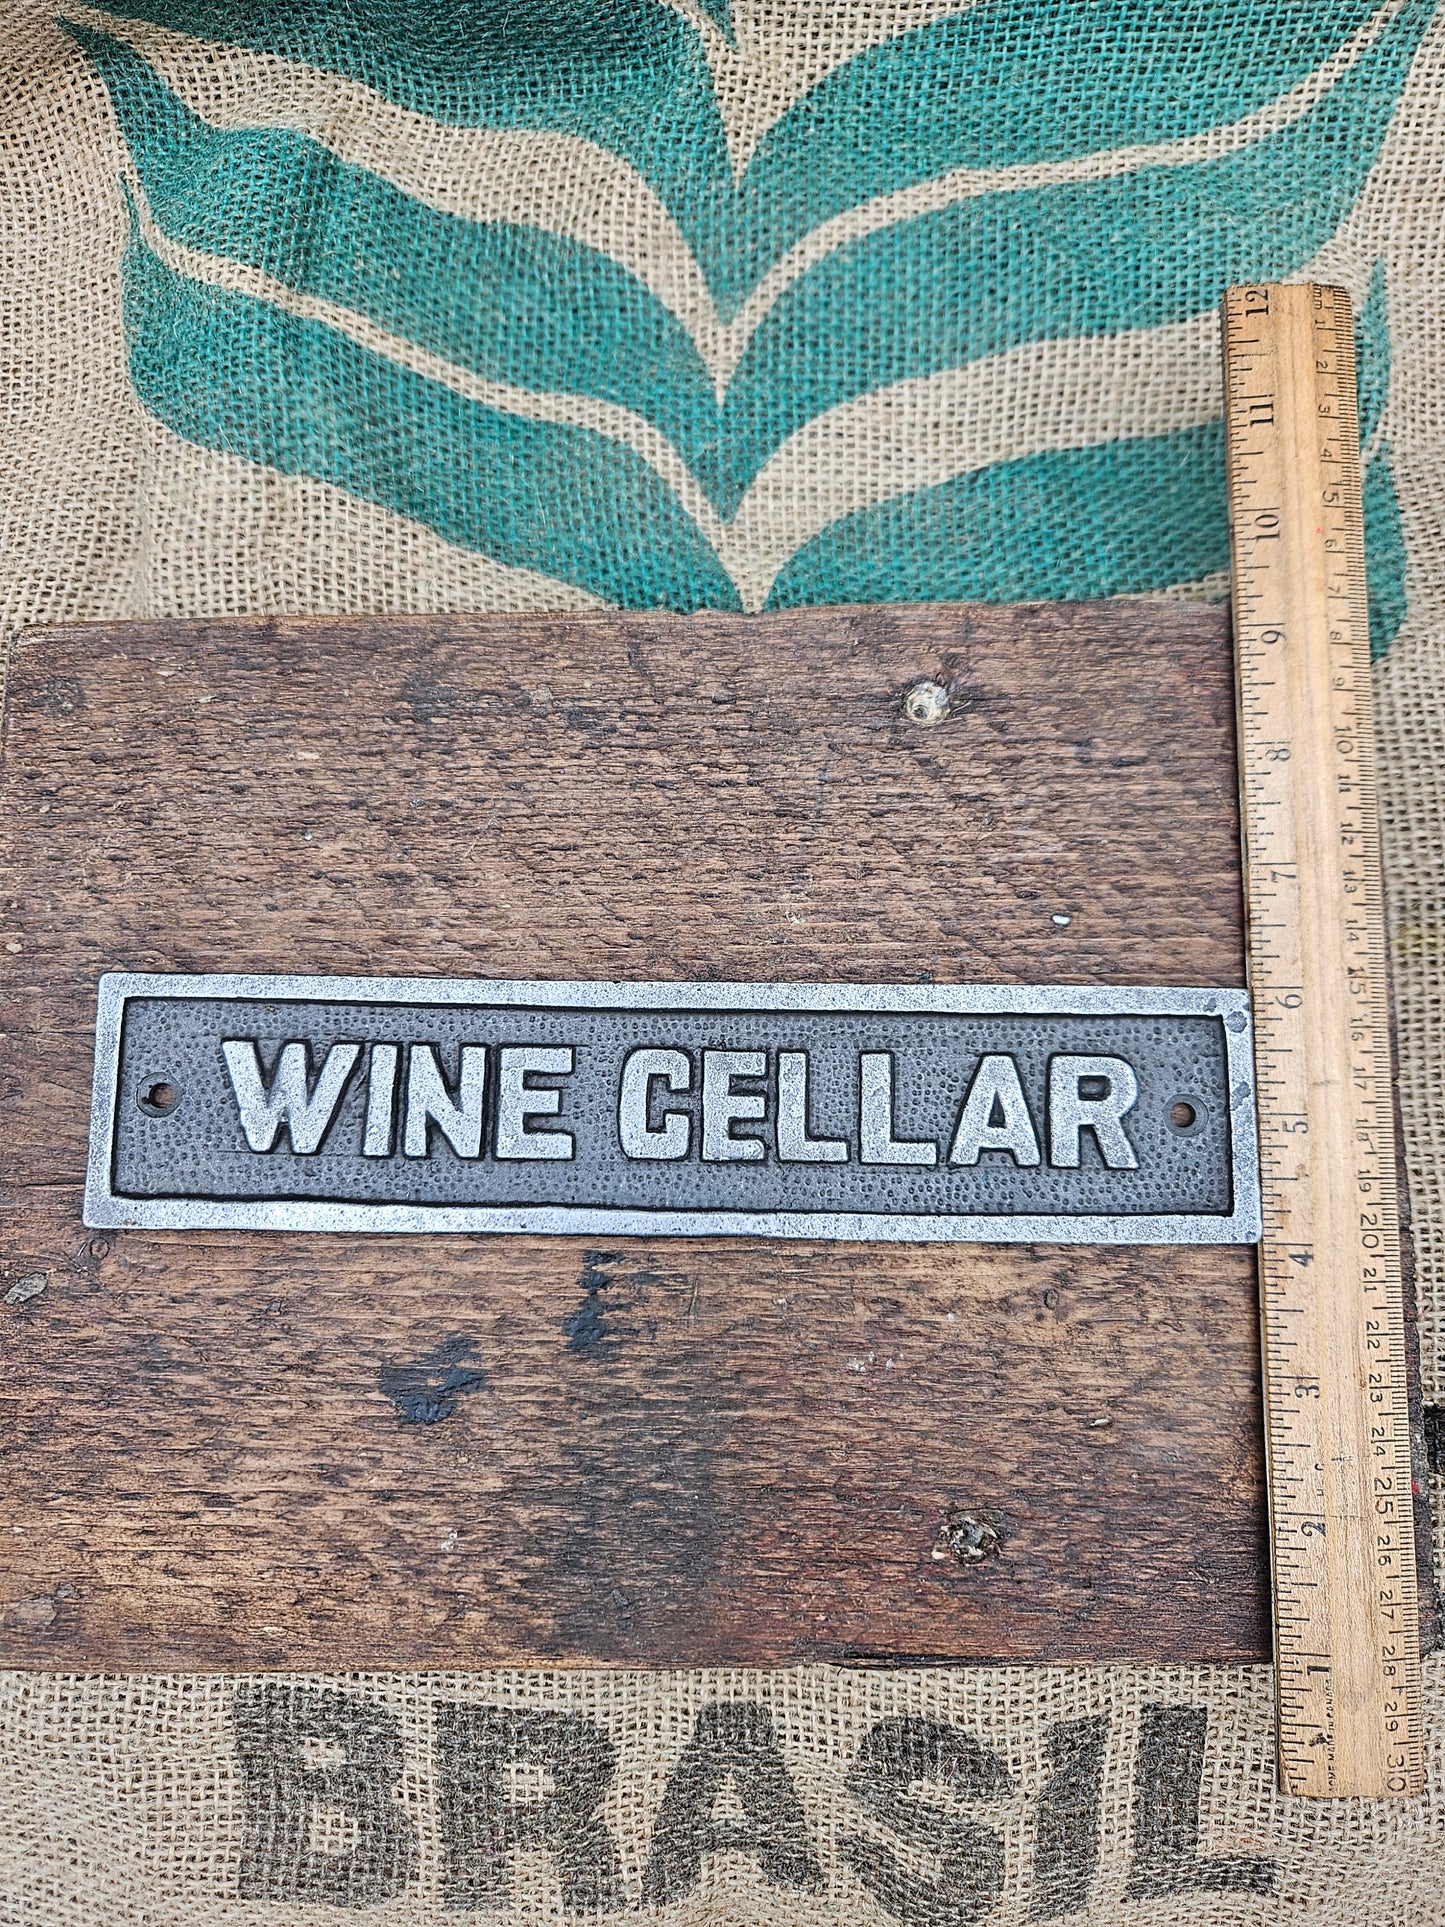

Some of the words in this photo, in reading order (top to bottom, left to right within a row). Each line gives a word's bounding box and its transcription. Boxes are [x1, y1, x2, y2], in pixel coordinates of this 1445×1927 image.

[1245, 288, 1269, 316] 12
[1314, 318, 1326, 326] 1
[1315, 360, 1328, 370] 2
[1249, 402, 1275, 427] 11
[1318, 404, 1330, 414] 3
[1320, 447, 1332, 458] 4
[1322, 489, 1340, 503] 5
[1254, 513, 1281, 542] 10
[1324, 538, 1337, 548] 6
[1328, 585, 1340, 593] 7
[1260, 629, 1286, 645] 9
[1329, 630, 1342, 641] 8
[1332, 677, 1345, 686] 9
[1334, 726, 1354, 754] 10
[1265, 748, 1291, 762] 8
[1337, 773, 1351, 794] 11
[1340, 821, 1355, 846] 12
[1270, 870, 1297, 884] 7
[1342, 869, 1357, 894] 13
[1345, 918, 1360, 942] 14
[1347, 966, 1367, 995] 15
[1275, 993, 1303, 1010] 6
[1350, 1016, 1365, 1042] 16
[1353, 1066, 1367, 1091] 17
[221, 1037, 575, 1160] WINE
[619, 1047, 1141, 1169] CELLAR
[1282, 1120, 1309, 1135] 5
[1356, 1117, 1370, 1142] 18
[1358, 1168, 1371, 1193] 19
[1360, 1213, 1379, 1249] 20
[1288, 1251, 1314, 1268] 4
[1363, 1267, 1377, 1293] 21
[1366, 1320, 1380, 1350] 22
[1294, 1383, 1321, 1400] 3
[1369, 1373, 1383, 1403] 23
[1371, 1427, 1386, 1457] 24
[1373, 1477, 1394, 1514] 25
[1300, 1520, 1327, 1537] 2
[1377, 1534, 1392, 1566] 26
[1379, 1589, 1394, 1620] 27
[1307, 1665, 1331, 1677] 1
[1381, 1646, 1397, 1677] 28
[1384, 1701, 1399, 1732] 29
[1386, 1754, 1406, 1792] 30
[232, 1684, 1280, 1924] BRASIL
